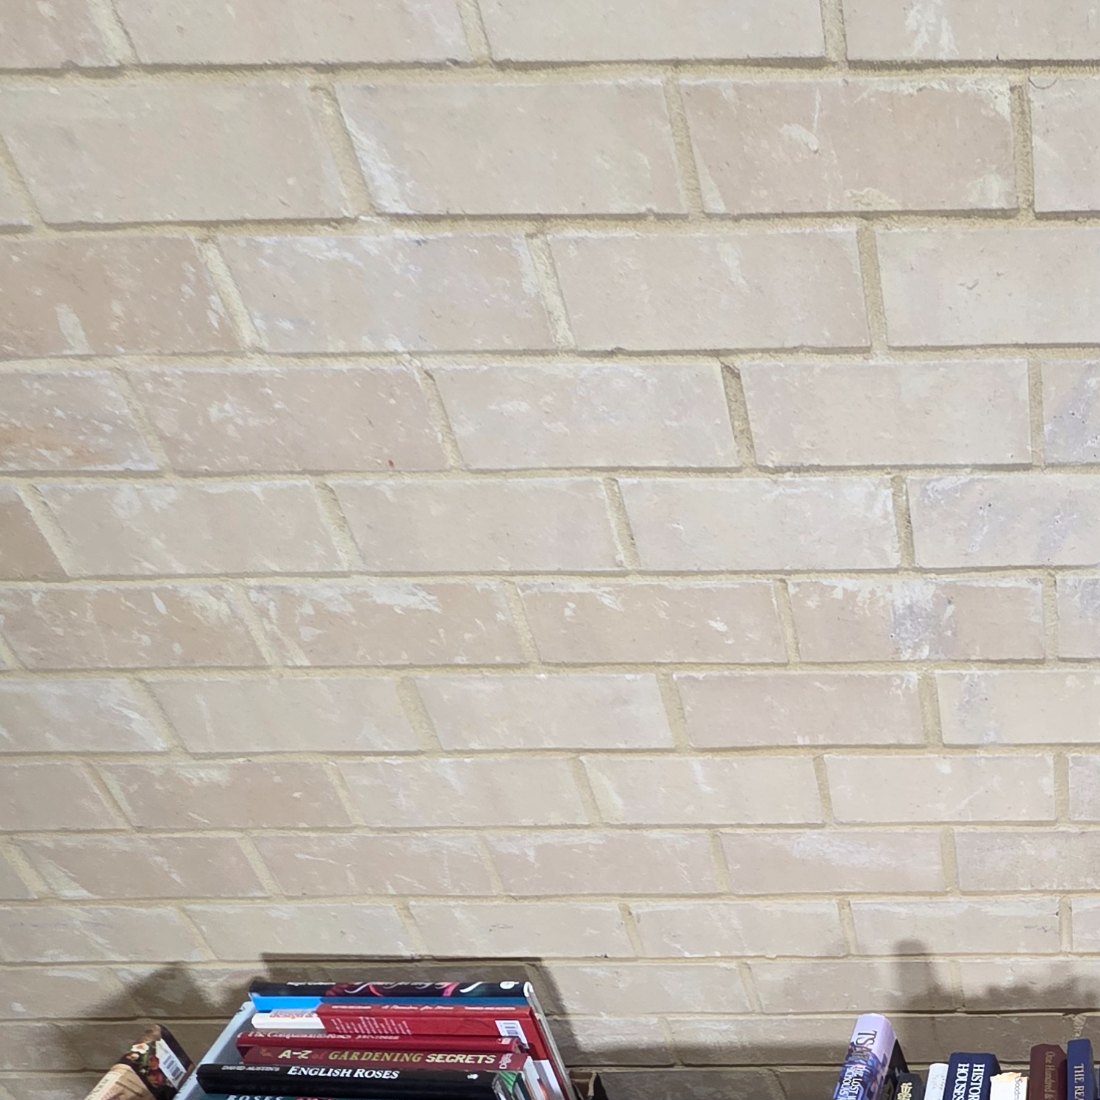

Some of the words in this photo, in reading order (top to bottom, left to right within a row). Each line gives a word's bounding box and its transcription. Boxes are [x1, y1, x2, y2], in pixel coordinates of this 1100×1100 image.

[328, 1050, 423, 1063] GARDENING
[425, 1053, 497, 1065] SECRETS
[287, 1065, 353, 1078] ENGLISH
[353, 1068, 400, 1080] ROSES
[1074, 1063, 1084, 1083] THE
